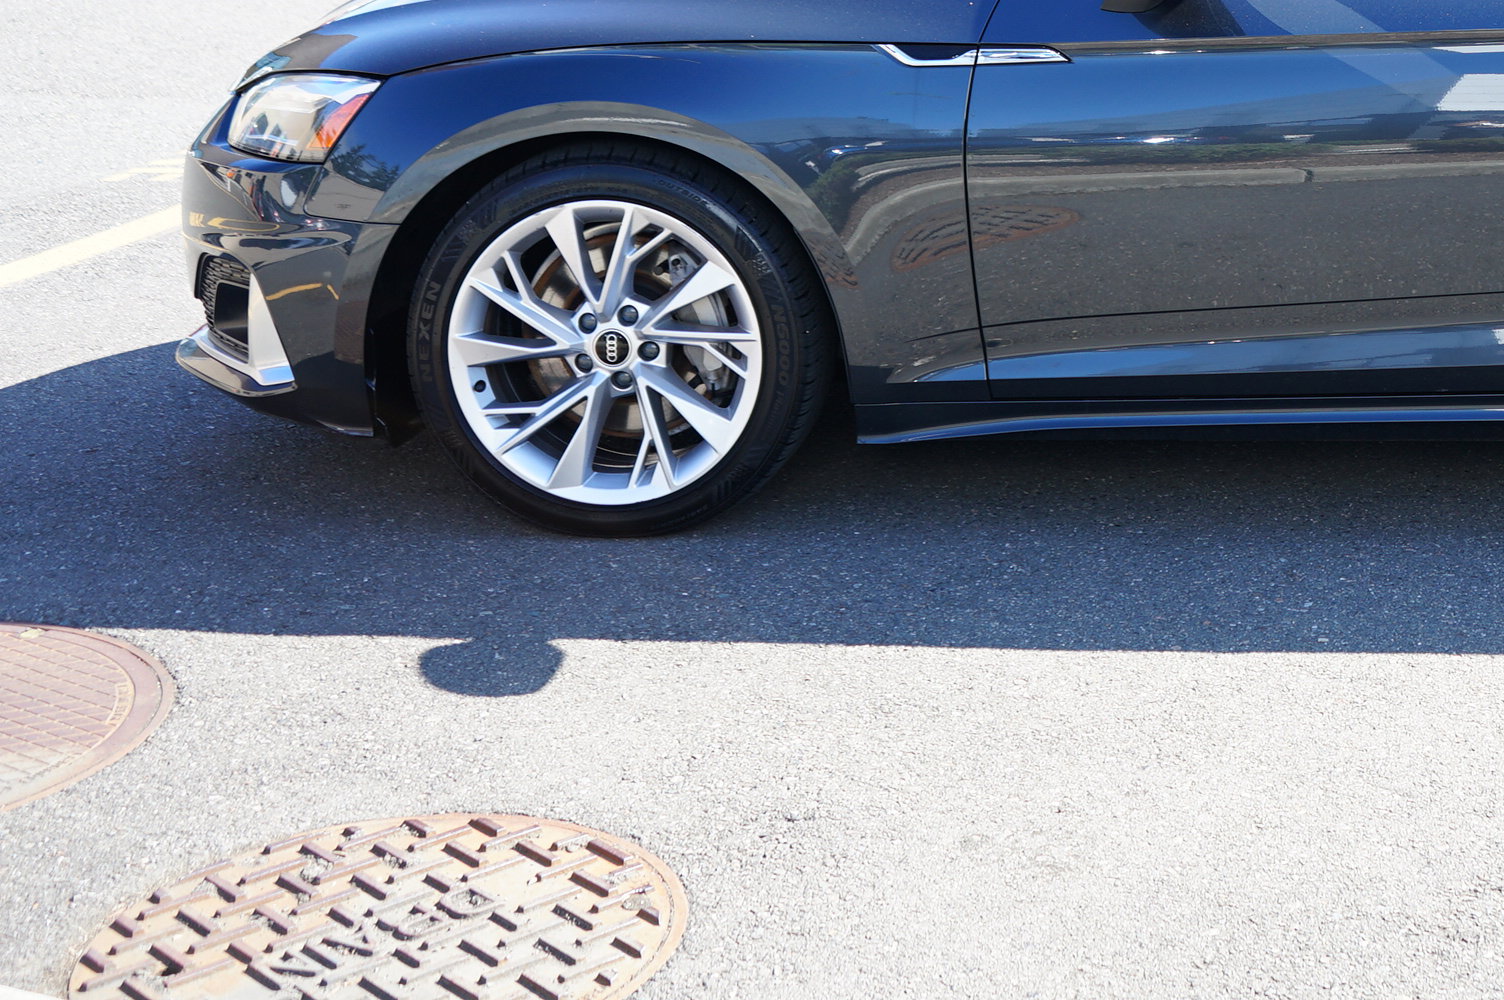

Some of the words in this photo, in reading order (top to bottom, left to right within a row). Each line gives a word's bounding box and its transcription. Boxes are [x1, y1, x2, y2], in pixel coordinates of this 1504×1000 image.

[419, 281, 441, 382] NEXEN
[771, 300, 790, 385] N5000
[244, 888, 502, 991] DRAIN
